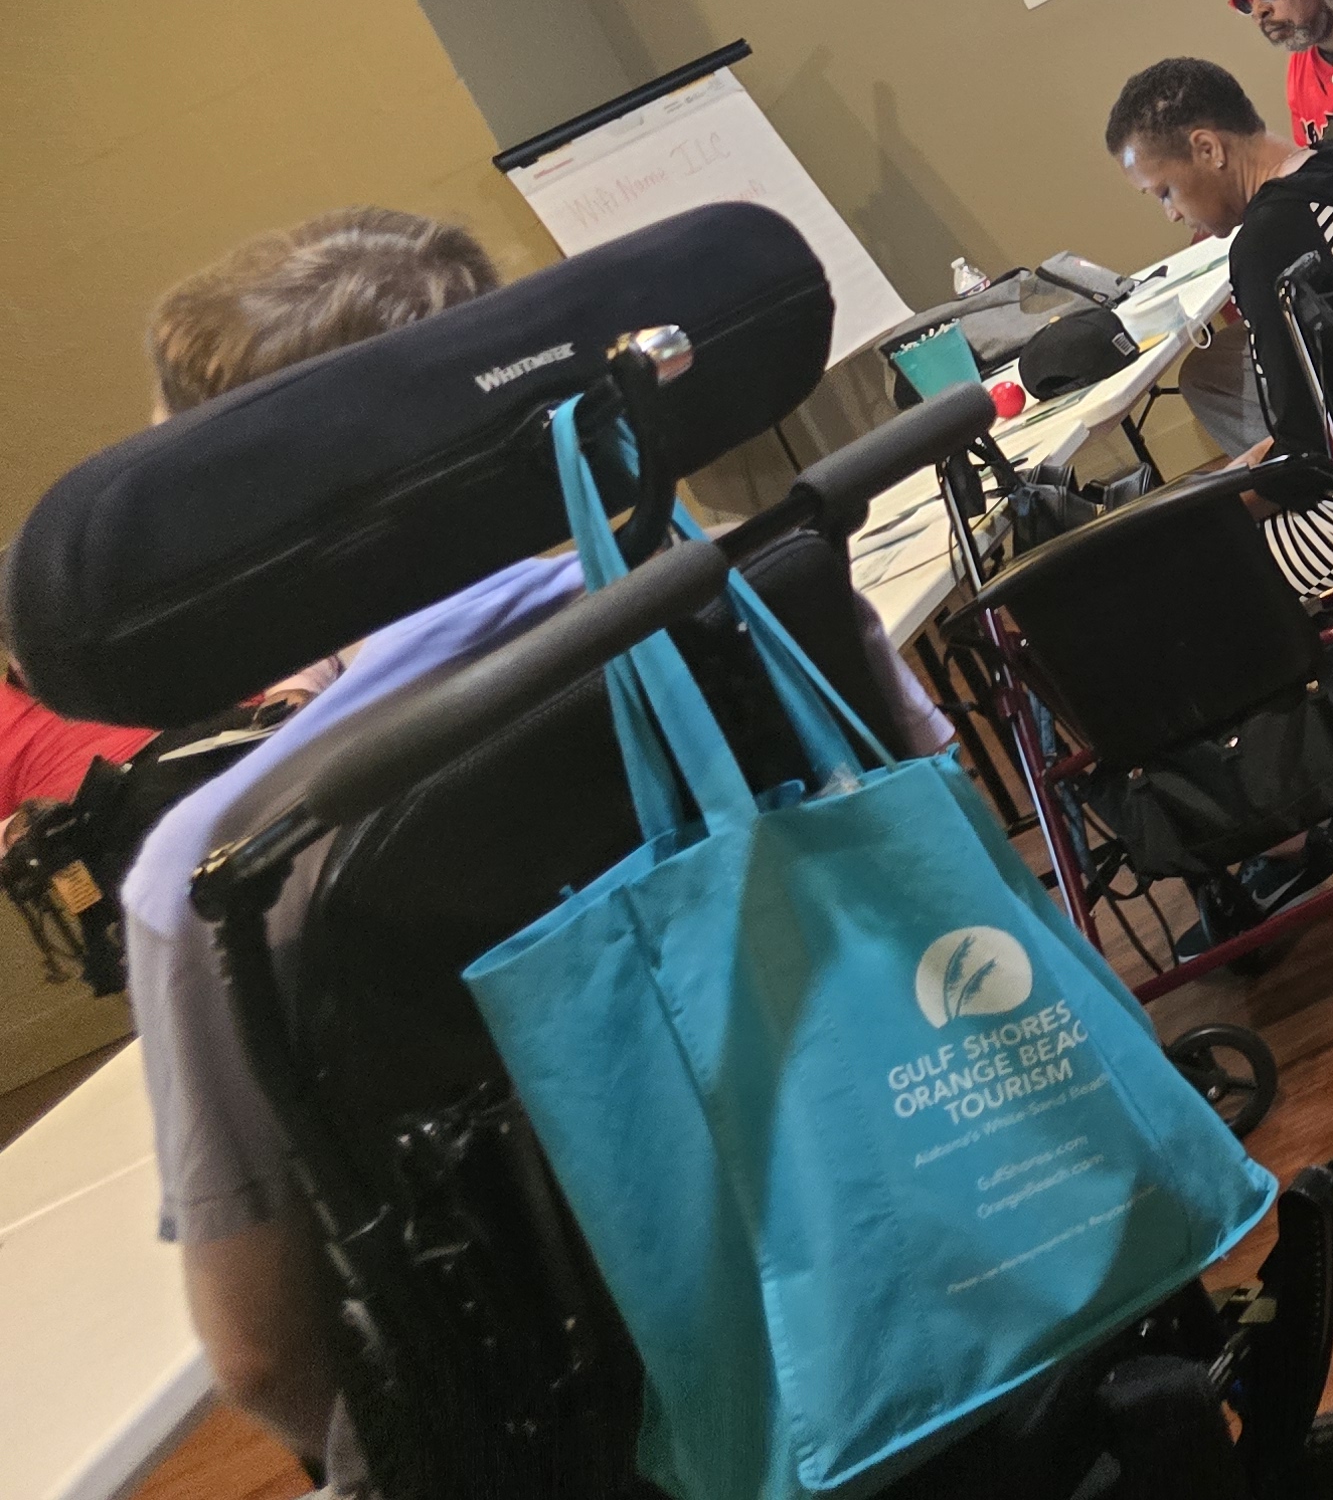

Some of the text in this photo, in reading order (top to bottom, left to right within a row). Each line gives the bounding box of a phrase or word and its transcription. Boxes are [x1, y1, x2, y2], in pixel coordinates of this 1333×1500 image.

[887, 1000, 1072, 1091] GULF SHORES
[894, 1018, 1089, 1119] ORANGE BEAC
[944, 1058, 1074, 1125] TOURISM
